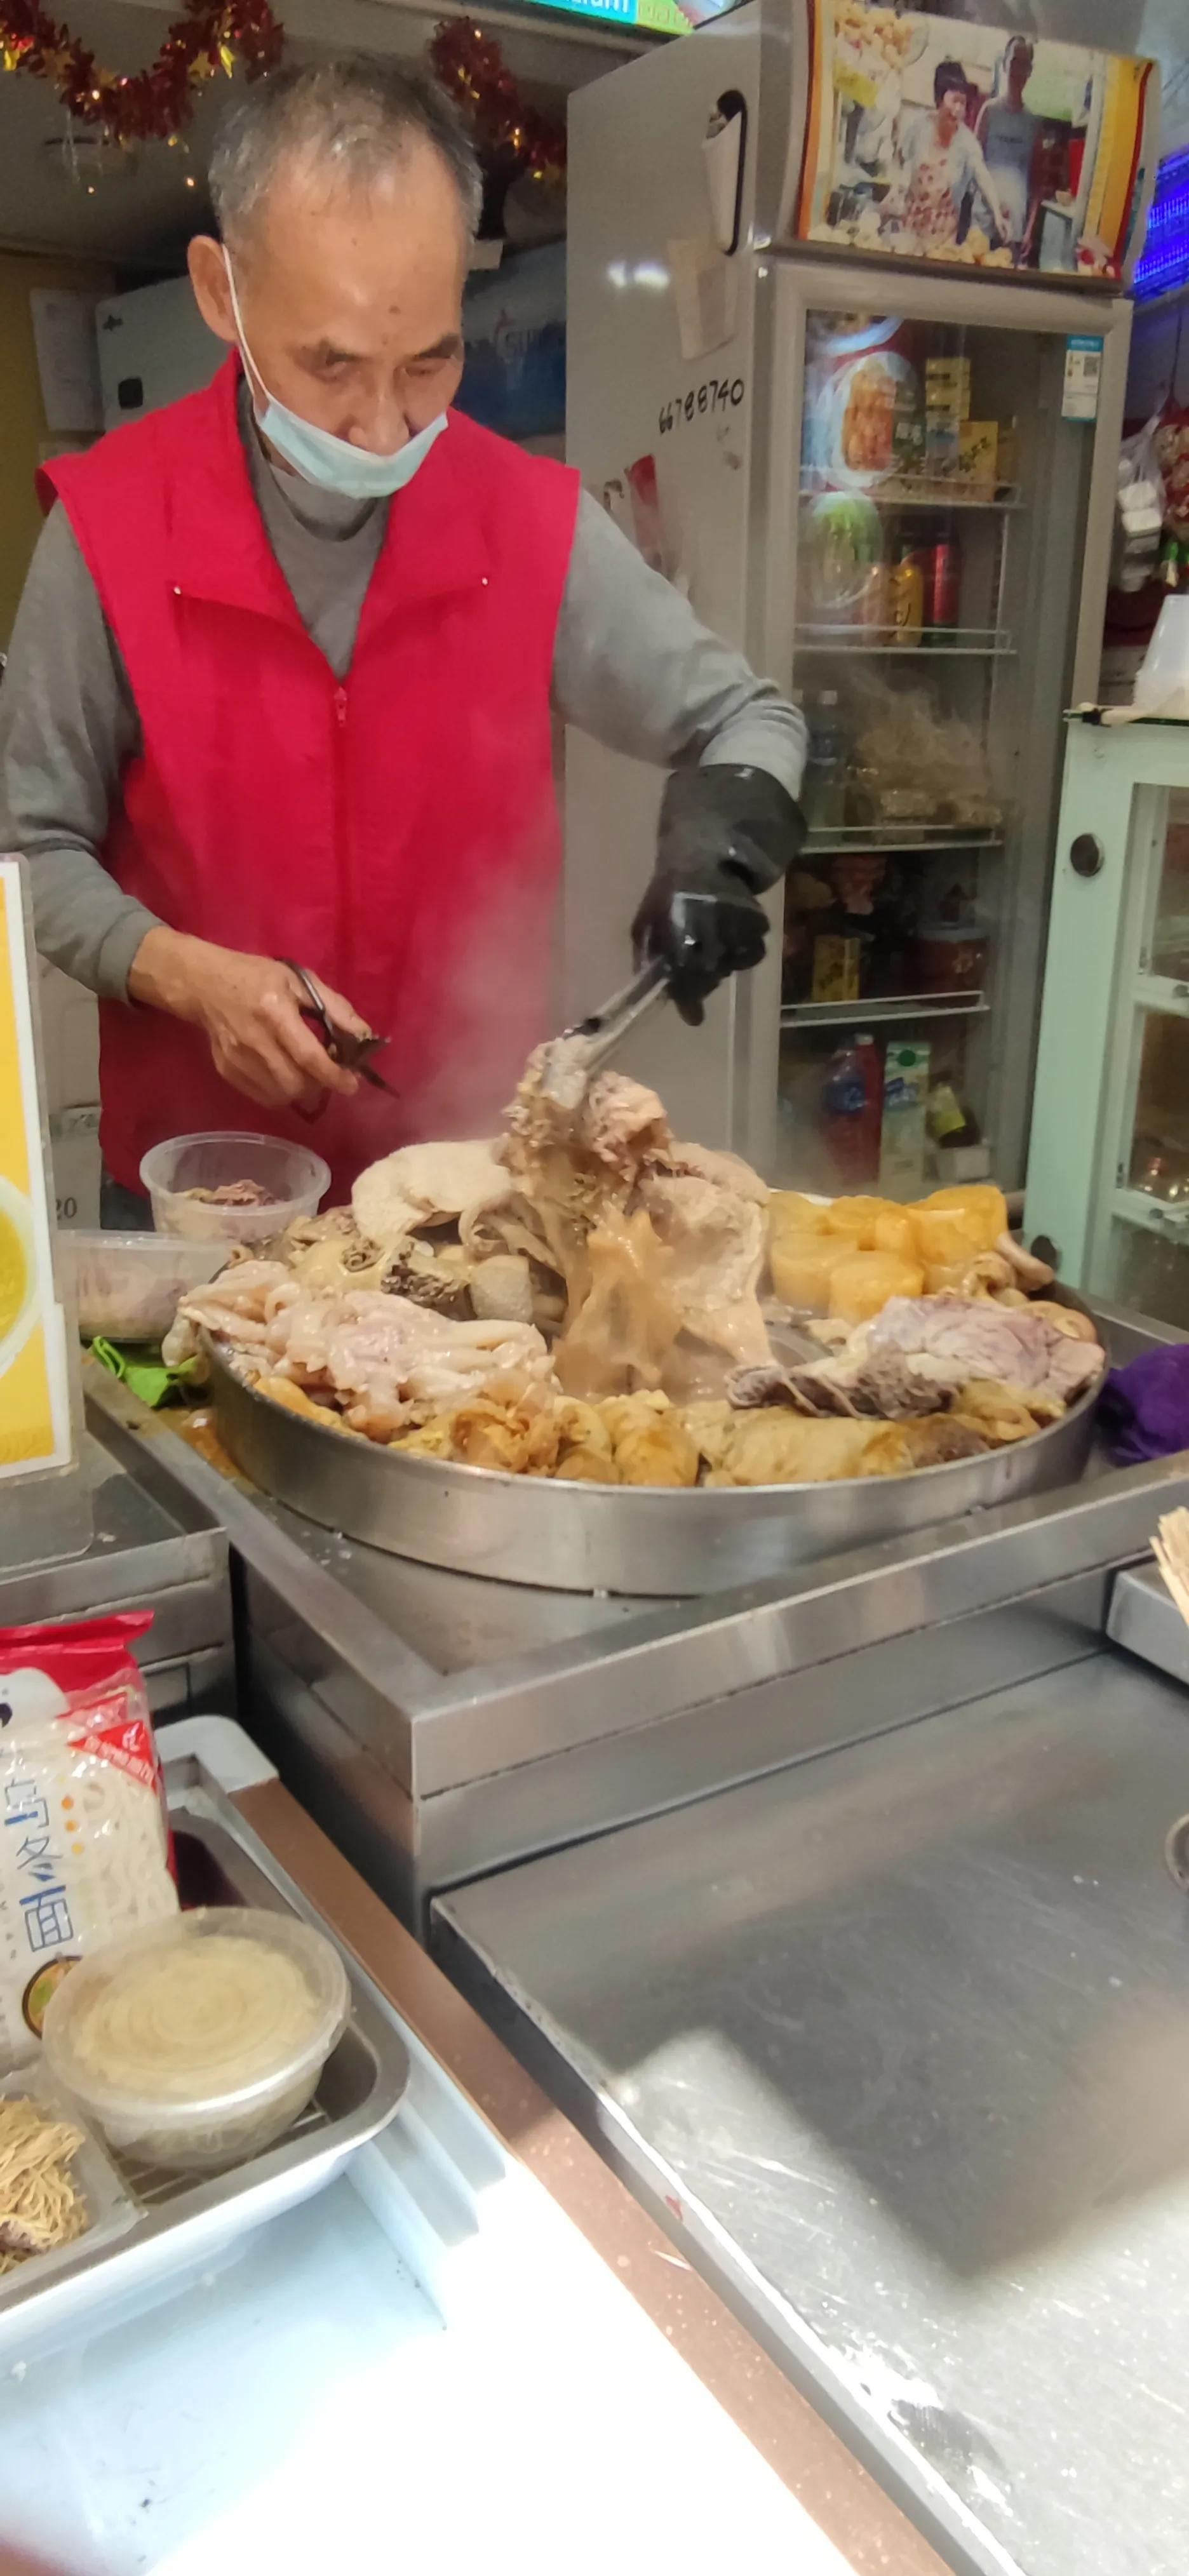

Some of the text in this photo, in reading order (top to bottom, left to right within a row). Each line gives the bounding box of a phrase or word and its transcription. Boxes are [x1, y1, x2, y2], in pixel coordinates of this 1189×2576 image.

[659, 379, 744, 434] 66788740
[4, 1778, 74, 1952] 乌冬面
